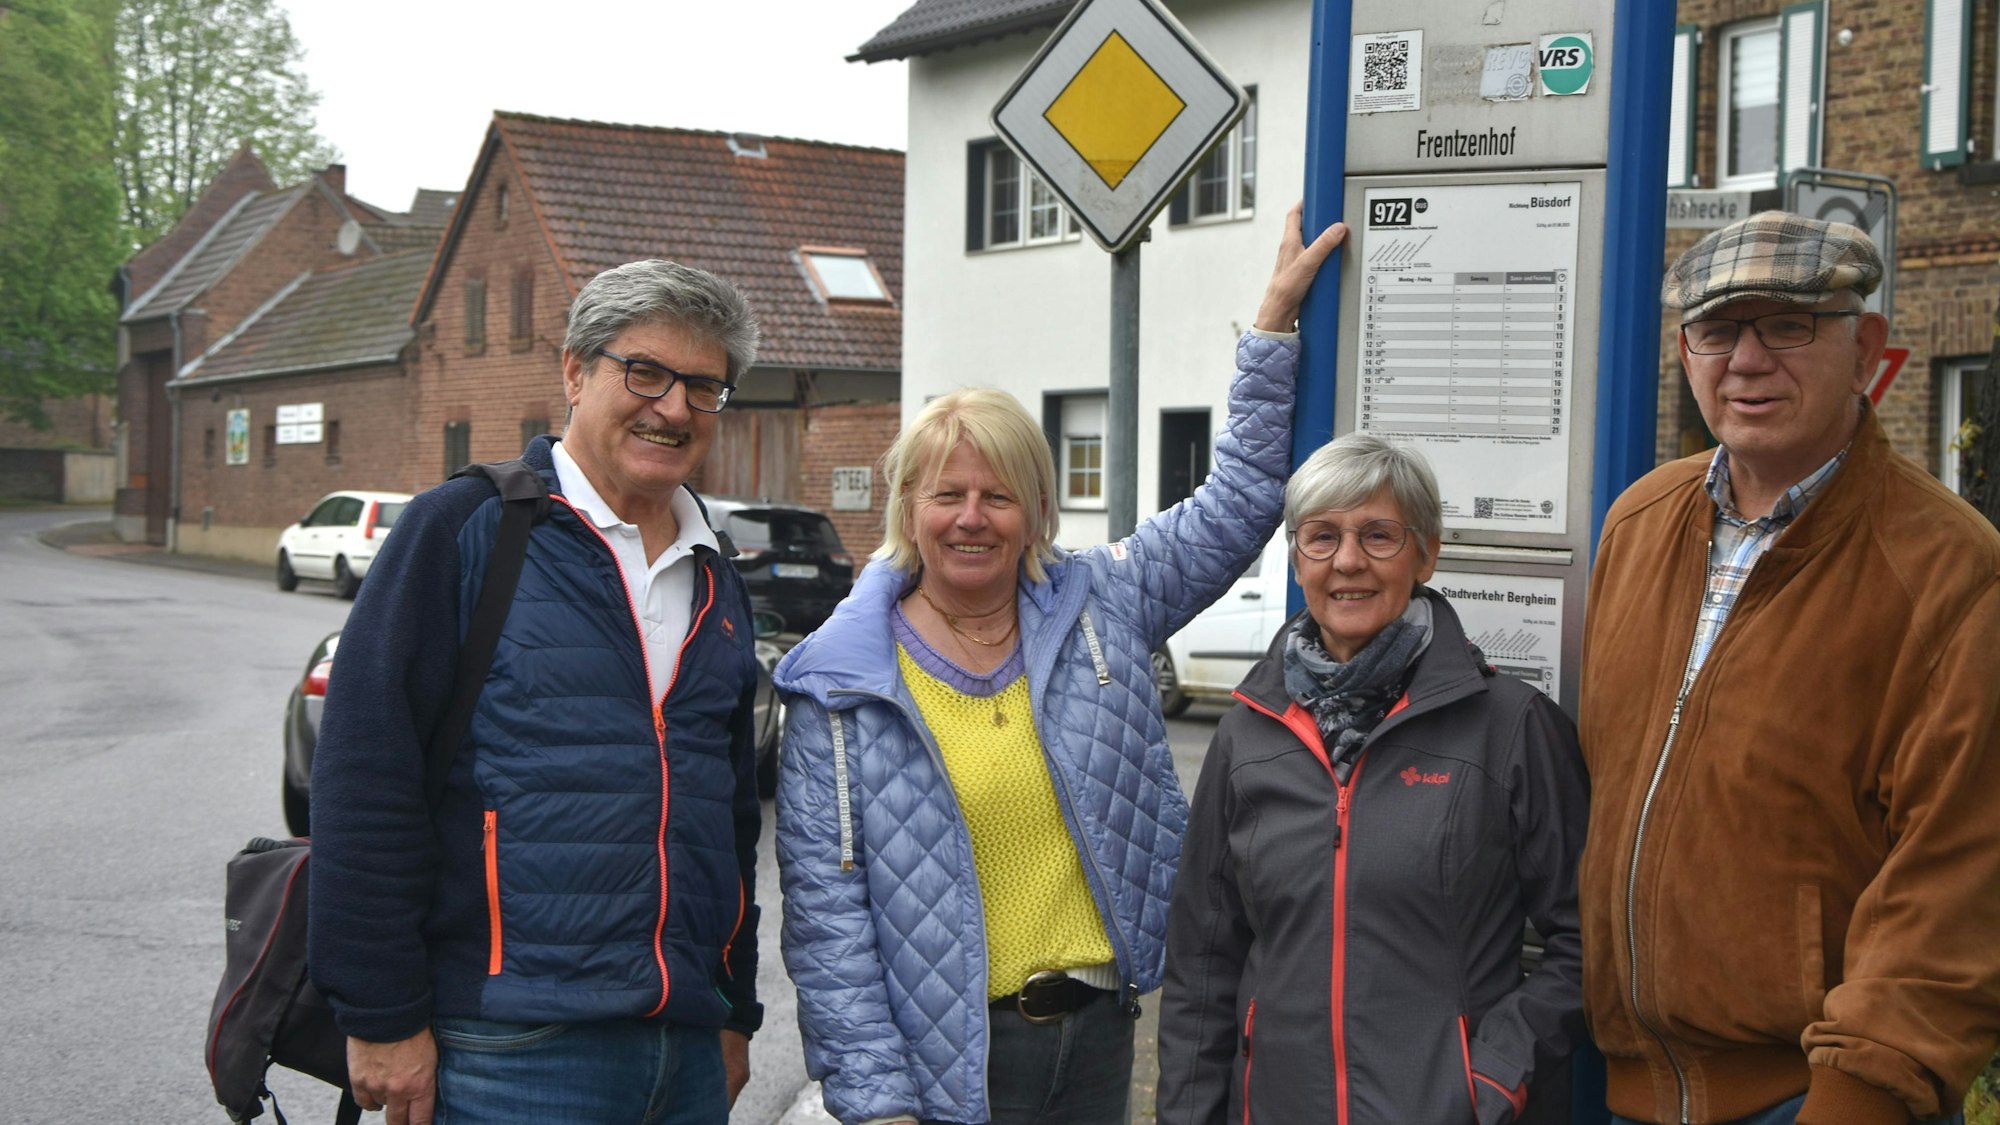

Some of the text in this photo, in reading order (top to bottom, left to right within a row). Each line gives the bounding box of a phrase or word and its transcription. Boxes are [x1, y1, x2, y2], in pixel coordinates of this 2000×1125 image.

[1539, 47, 1580, 67] VRS
[1416, 126, 1517, 158] Frentzenhof
[1374, 201, 1407, 223] 972
[1530, 196, 1572, 208] Büsdorf
[1668, 196, 1738, 220] hshecke
[1551, 426, 1559, 434] 21
[1441, 586, 1557, 607] Stadtverkehr Bergheim
[1083, 627, 1104, 664] FRIEDA
[1095, 664, 1105, 674] &
[831, 717, 841, 727] &
[833, 728, 848, 769] FRIEDA
[1422, 771, 1452, 785] kilpi
[838, 774, 851, 828] FREDDIES
[843, 828, 853, 838] &
